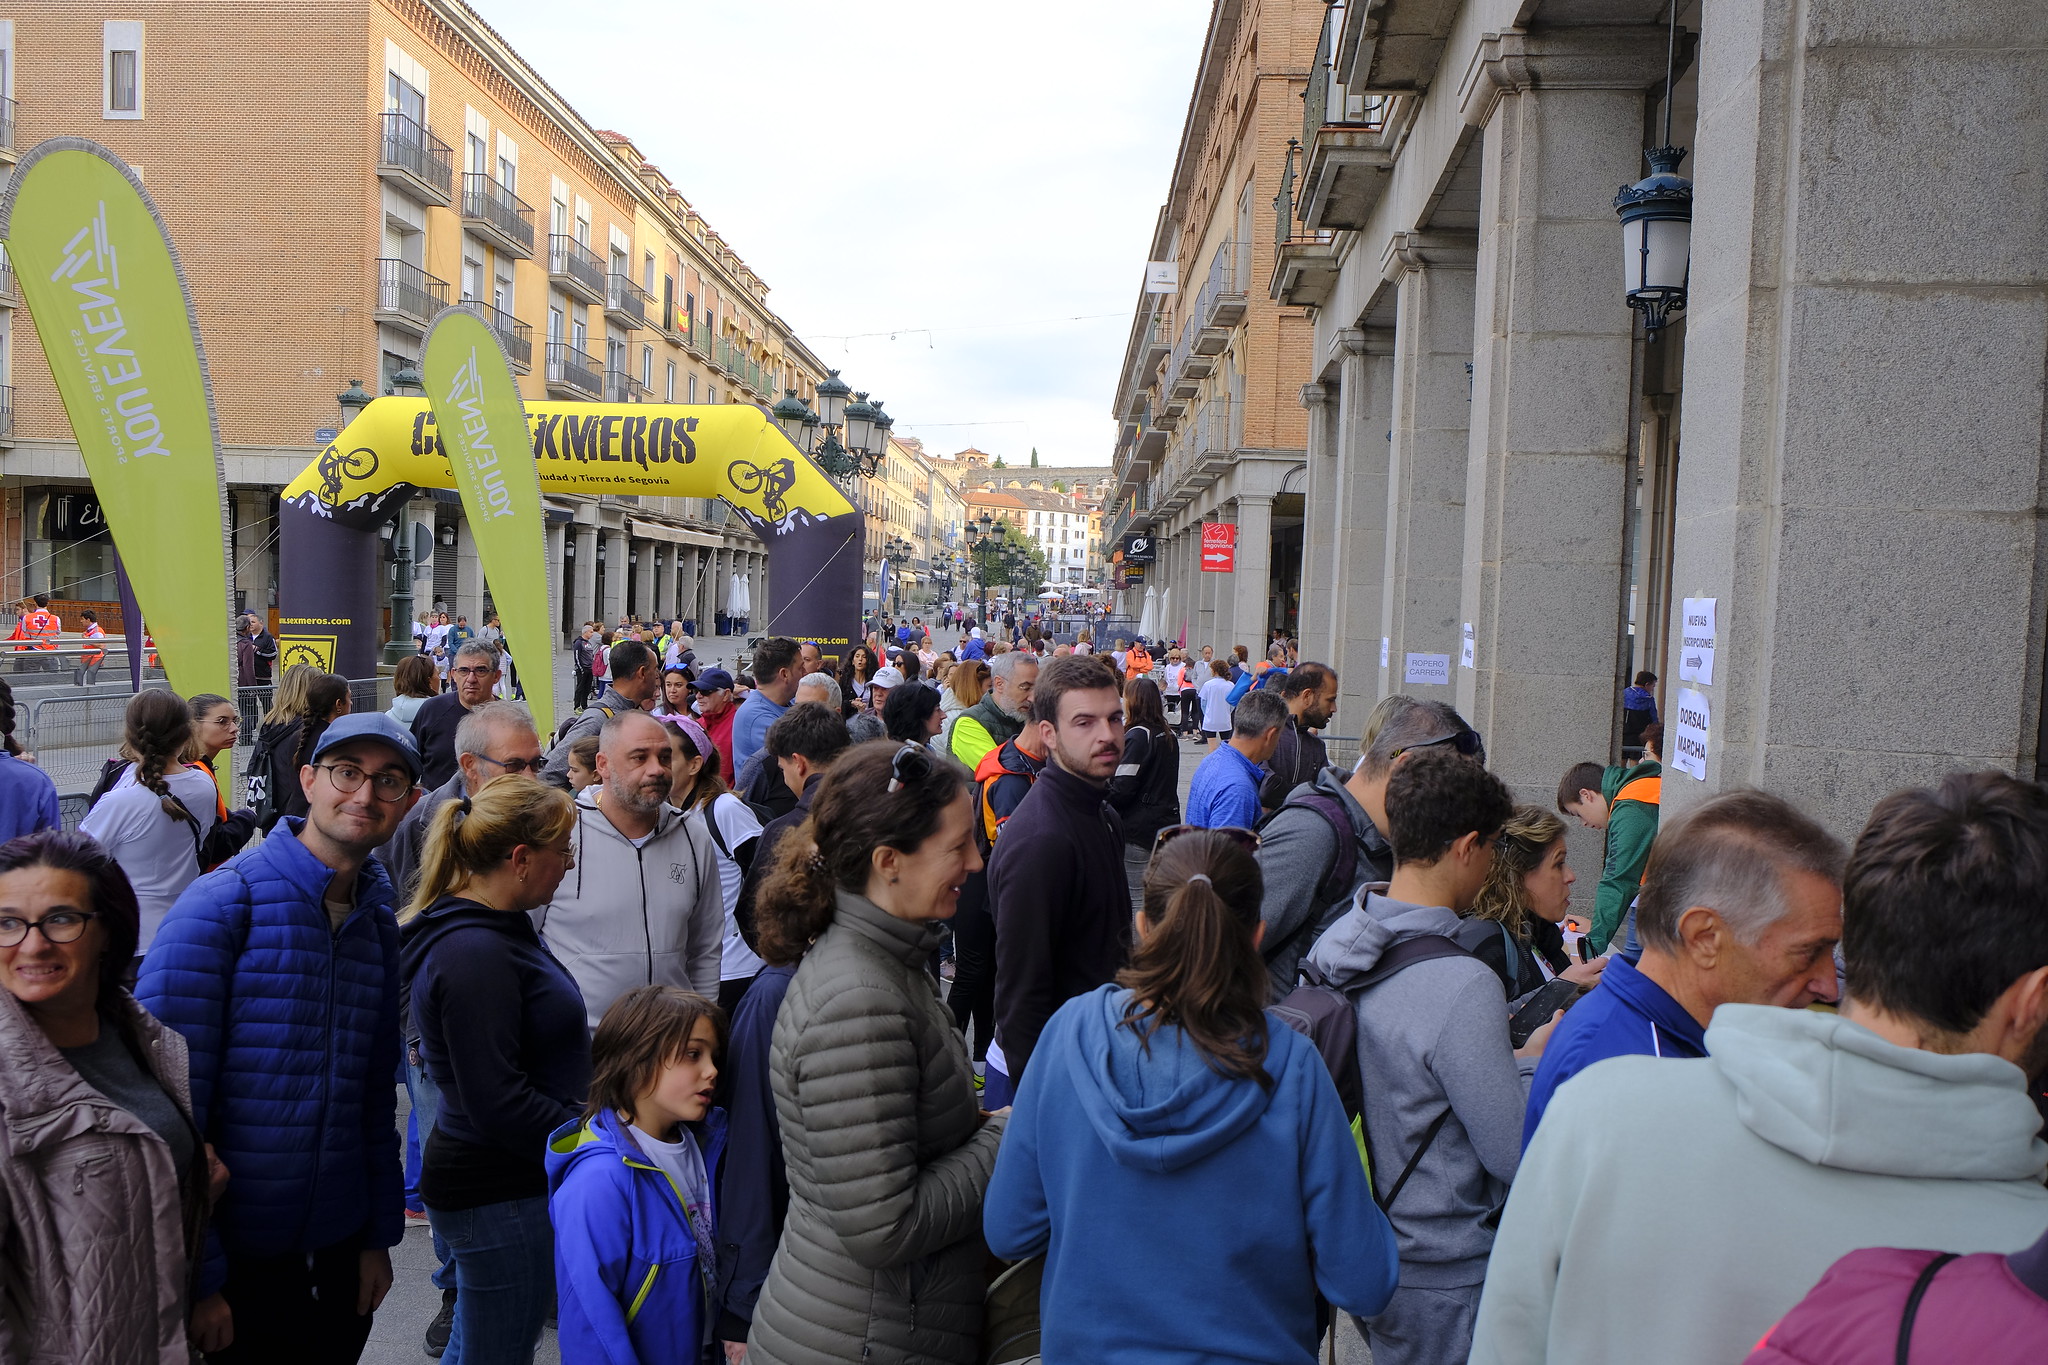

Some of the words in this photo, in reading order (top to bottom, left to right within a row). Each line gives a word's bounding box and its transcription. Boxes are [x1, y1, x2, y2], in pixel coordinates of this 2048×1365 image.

[539, 473, 568, 482] iudad
[571, 475, 577, 483] y
[579, 474, 611, 483] Tierra
[613, 475, 626, 483] de
[628, 476, 670, 486] Segovia
[1688, 615, 1707, 627] NUEVAS
[1412, 659, 1444, 668] ROPERO
[1409, 668, 1446, 677] CARRERA
[1680, 707, 1707, 731] DORSAL
[1677, 735, 1706, 761] MARCHA
